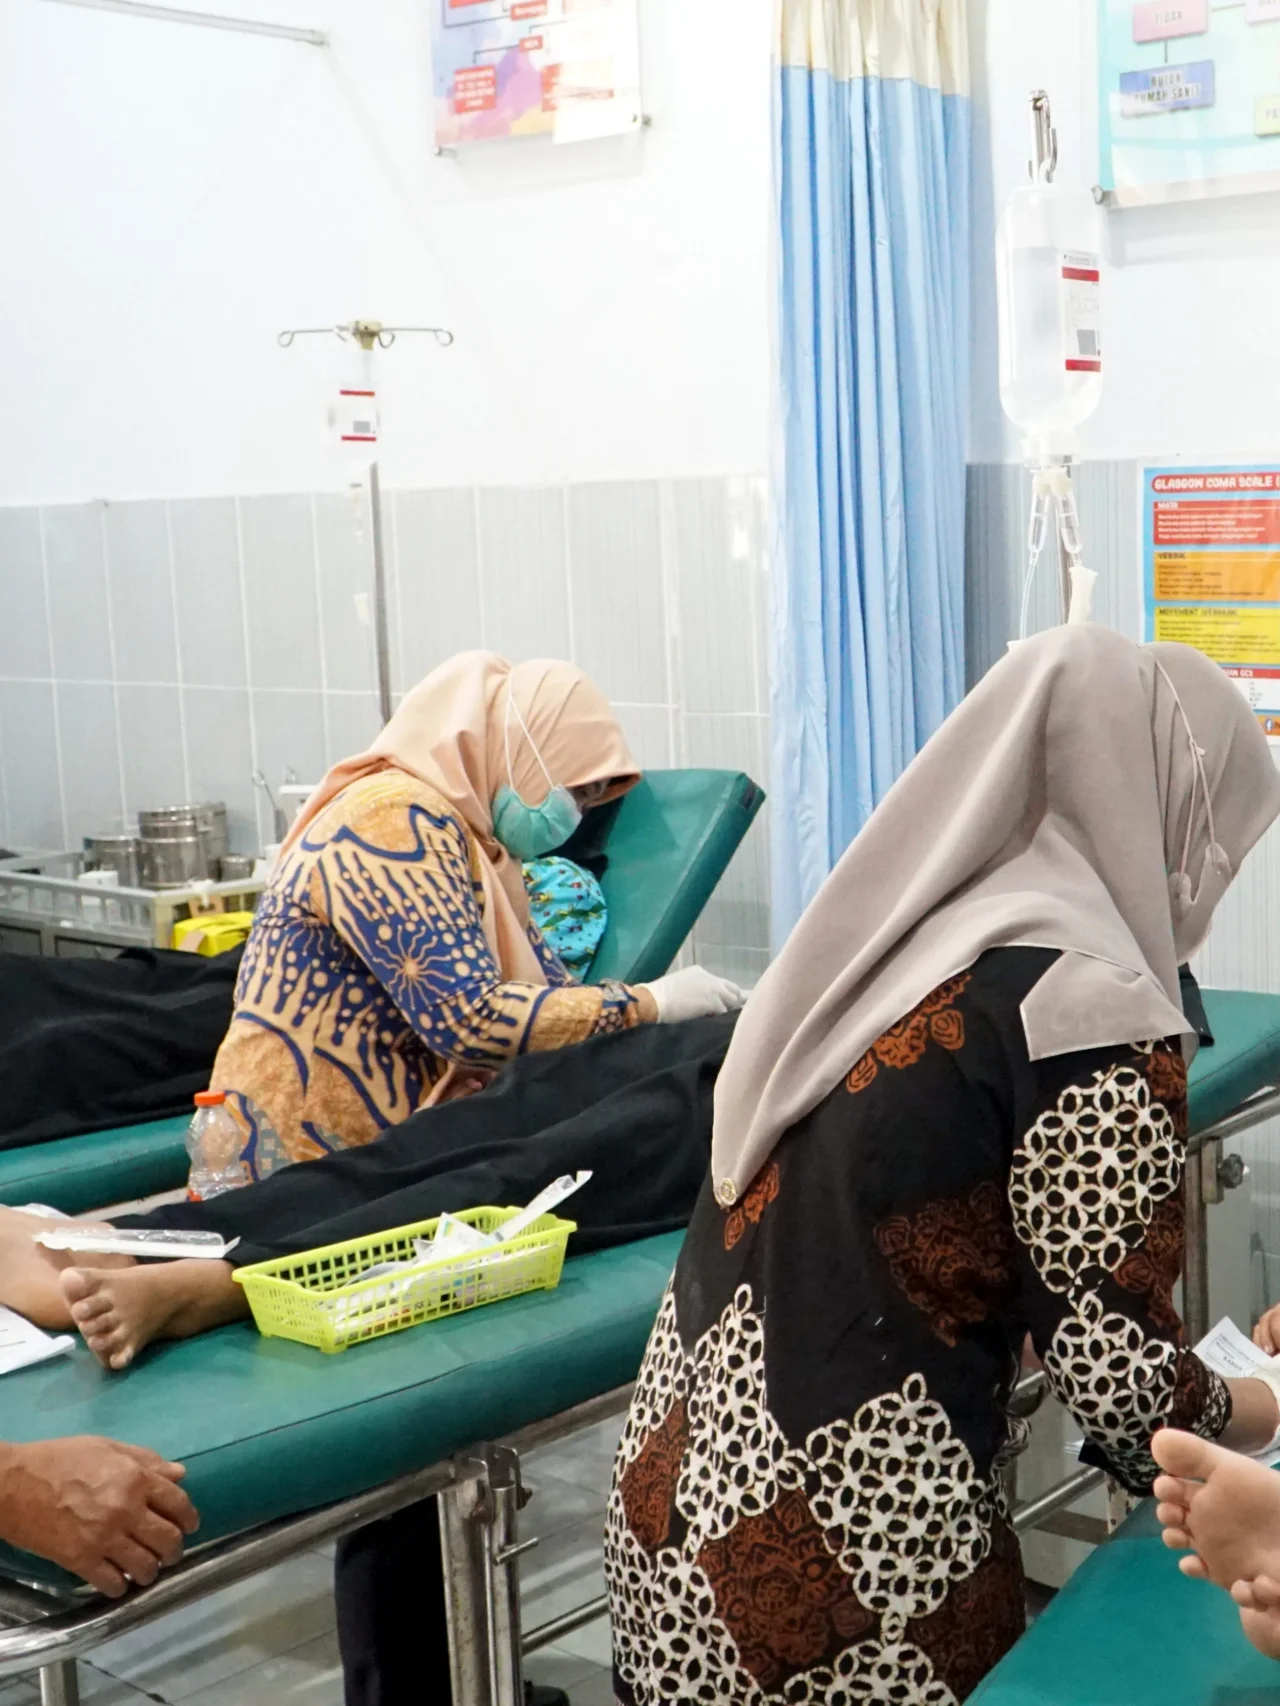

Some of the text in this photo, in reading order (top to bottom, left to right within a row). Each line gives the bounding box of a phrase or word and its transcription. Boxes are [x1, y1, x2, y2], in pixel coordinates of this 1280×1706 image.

[1153, 10, 1183, 26] TIDAK
[1154, 478, 1204, 490] GLASGOW
[1206, 477, 1237, 488] COMA
[1239, 475, 1273, 487] SCALE
